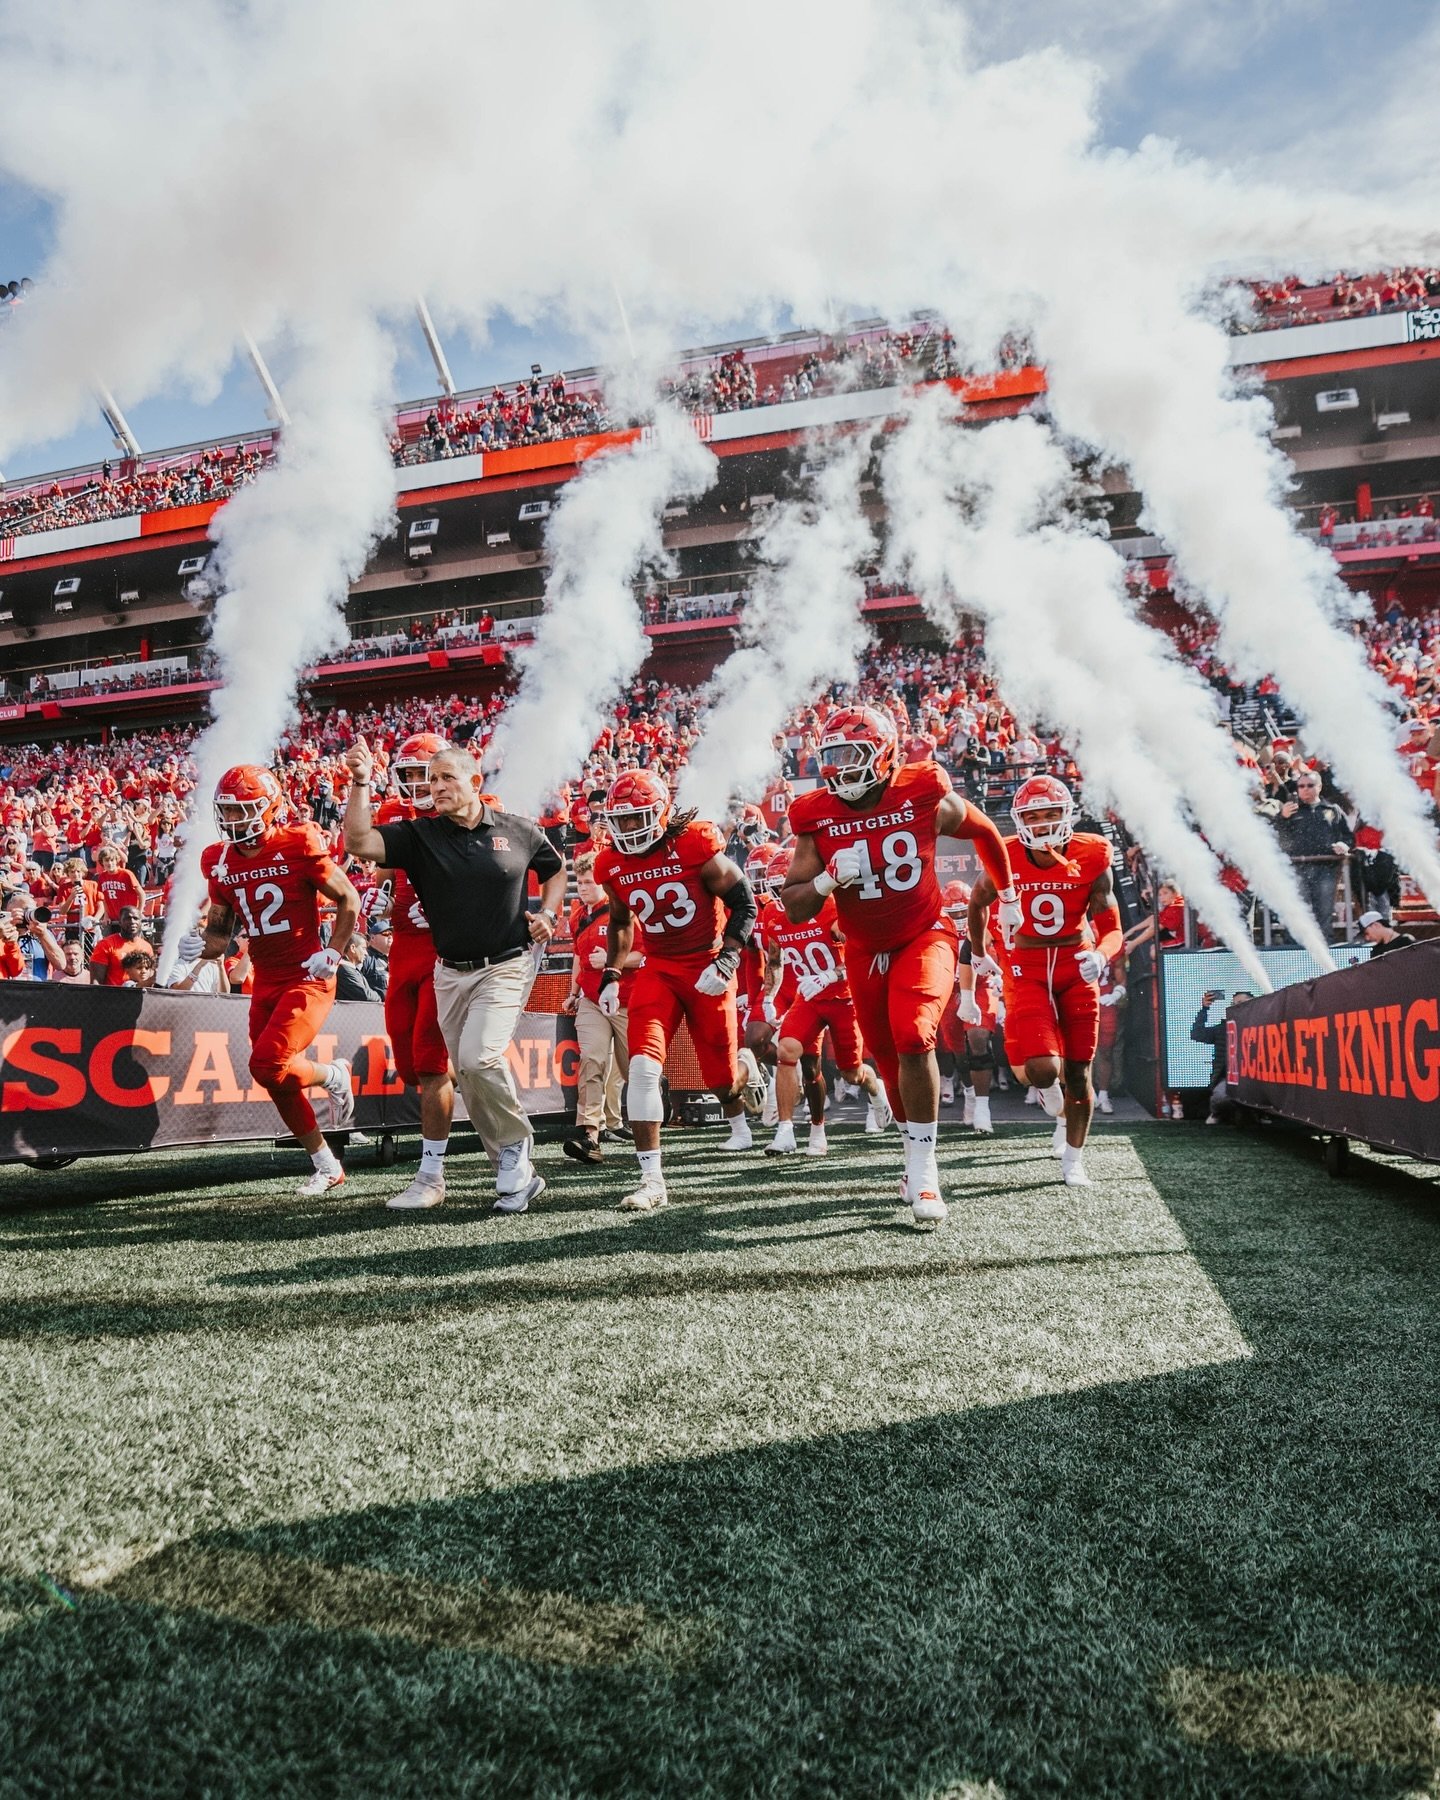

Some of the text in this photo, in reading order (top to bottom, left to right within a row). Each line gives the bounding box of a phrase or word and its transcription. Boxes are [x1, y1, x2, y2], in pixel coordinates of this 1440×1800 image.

[829, 809, 915, 837] RUTGERS
[491, 837, 511, 851] R
[222, 864, 290, 886] RUTGERS
[619, 864, 683, 885] RUTGERS
[851, 830, 923, 900] 48
[107, 889, 118, 900] R
[1014, 882, 1080, 892] UTGER
[234, 882, 291, 937] 12
[628, 881, 697, 934] 23
[1030, 893, 1066, 936] 9
[777, 927, 823, 943] RUTGERS
[782, 941, 837, 980] 80
[1011, 965, 1023, 977] R
[1240, 1016, 1329, 1090] SCARLET
[1334, 998, 1440, 1102] KNIG
